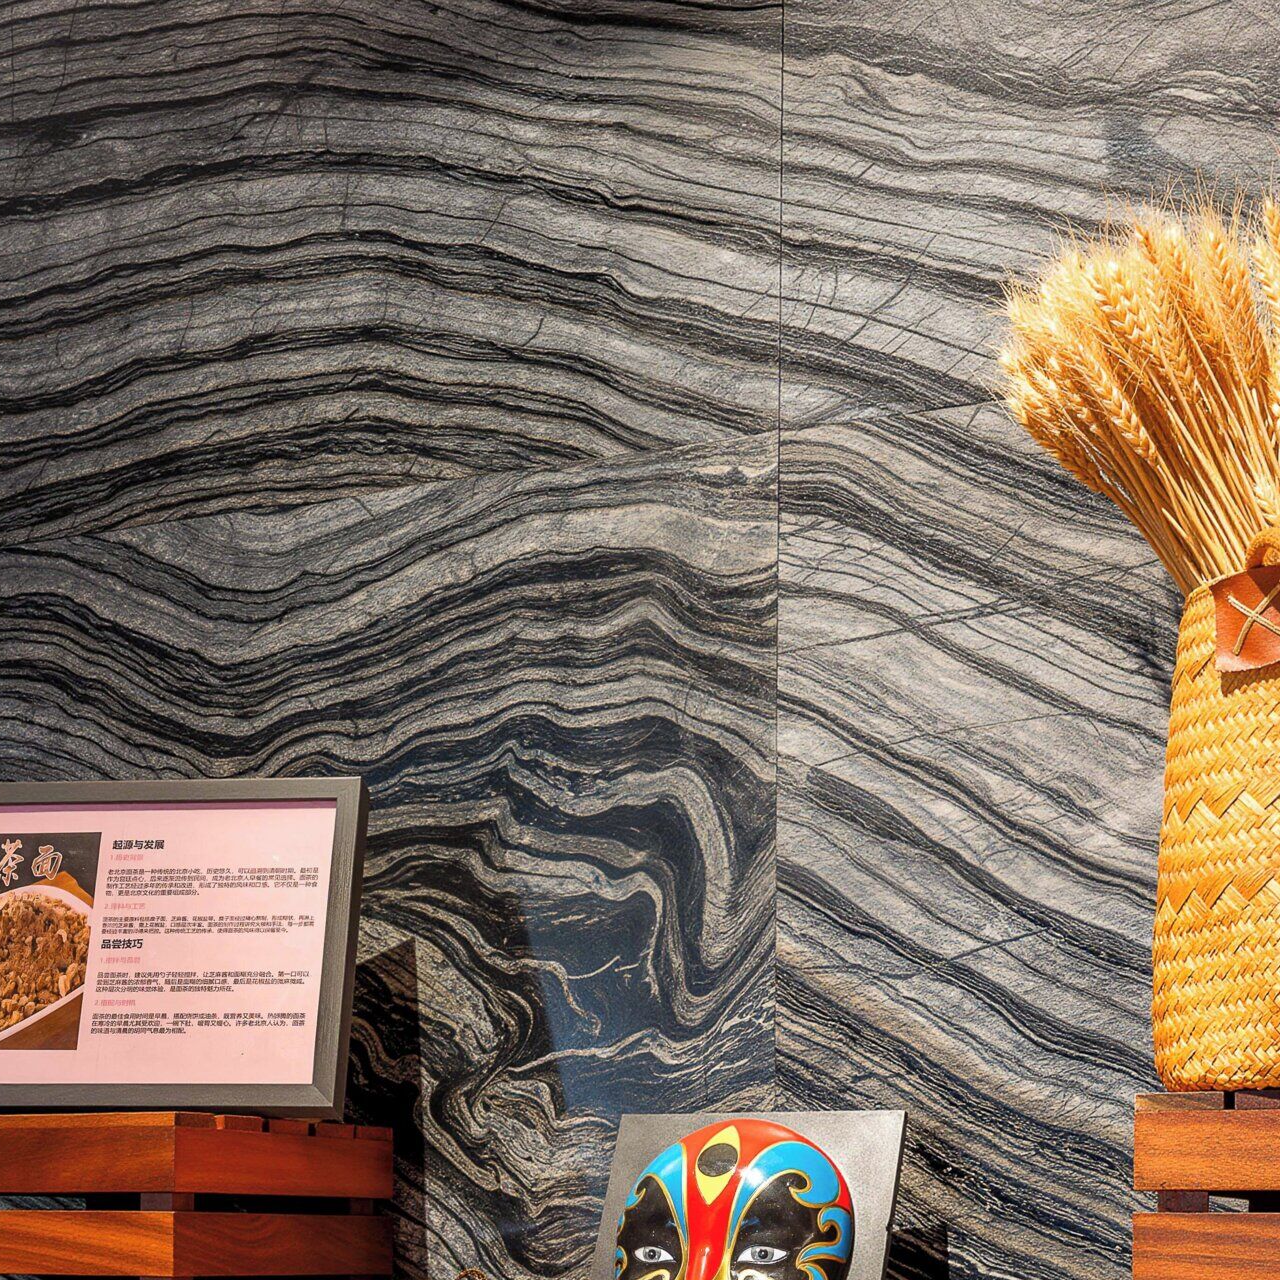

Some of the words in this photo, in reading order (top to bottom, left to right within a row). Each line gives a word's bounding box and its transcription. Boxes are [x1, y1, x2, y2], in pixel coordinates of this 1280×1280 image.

[112, 840, 165, 850] 起源与发展
[101, 938, 144, 949] 品尝技巧
